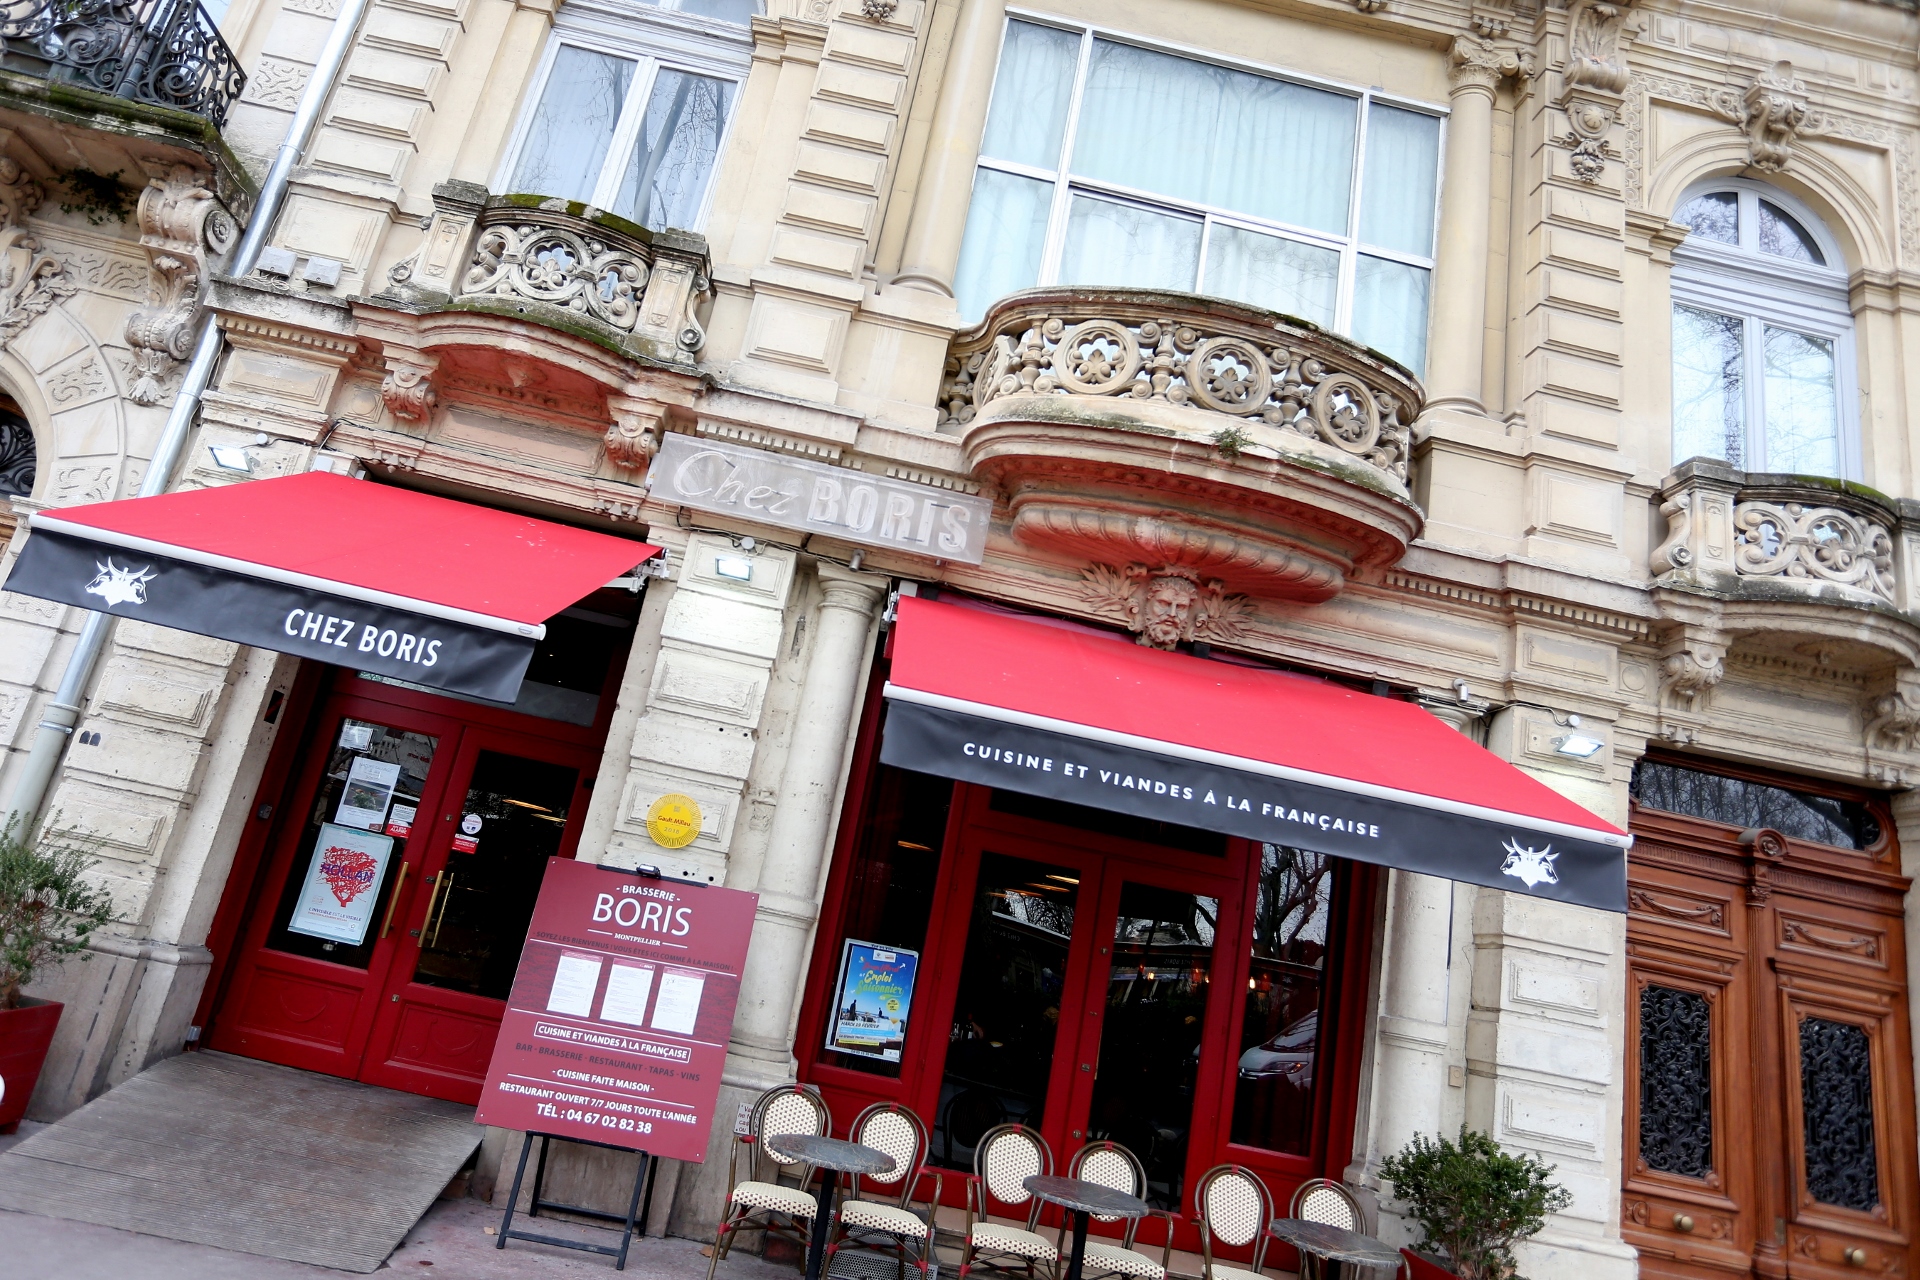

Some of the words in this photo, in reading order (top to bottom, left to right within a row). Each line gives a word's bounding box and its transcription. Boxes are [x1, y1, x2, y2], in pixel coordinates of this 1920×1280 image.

[673, 450, 800, 515] Chez
[806, 475, 971, 552] BORIS
[285, 608, 355, 647] CHEZ
[358, 624, 443, 667] BORIS
[963, 742, 1053, 772] CUISINE
[1064, 762, 1089, 779] ET
[1099, 769, 1193, 800] VIANDES
[1203, 789, 1216, 805] À
[1227, 795, 1251, 812] LA
[1262, 802, 1380, 838] FRANÇAISE
[622, 885, 676, 902] BRASSERIE
[592, 893, 693, 936] BORIS
[536, 931, 558, 940] SOYEZ
[571, 938, 609, 949] BIENVENUS
[614, 945, 632, 954] VOUS
[633, 946, 649, 956] ÊTES
[660, 952, 685, 963] COMME
[686, 956, 692, 964] À
[702, 960, 730, 970] MAISON
[614, 932, 661, 947] MONTPELLIER
[864, 969, 892, 984] Emploi
[538, 1025, 571, 1038] CUISINE
[572, 1032, 584, 1040] ET
[584, 1034, 620, 1047] VIANDES
[620, 1039, 627, 1048] À
[628, 1042, 640, 1050] LA
[640, 1044, 688, 1058] FRANÇAISE
[516, 1042, 532, 1052] BAR
[538, 1046, 583, 1061] BRASSERIE
[589, 1056, 644, 1071] RESTAURANT
[649, 1066, 675, 1077] TAPAS
[681, 1072, 700, 1082] VINS
[556, 1068, 590, 1082] CUISINE
[591, 1074, 615, 1086] FAITE
[615, 1079, 650, 1092] MAISON
[499, 1082, 555, 1098] RESTAURANT
[555, 1092, 590, 1106] OUVERT
[591, 1098, 604, 1108] 7/7
[604, 1101, 632, 1113] JOURS
[634, 1105, 662, 1118] TOUTE
[662, 1110, 697, 1124] L'ANNÉE
[537, 1102, 558, 1118] TÉL
[567, 1109, 582, 1122] 04
[584, 1112, 600, 1124] 67
[601, 1115, 616, 1128] 02
[619, 1118, 635, 1132] 82
[636, 1121, 652, 1134] 38
